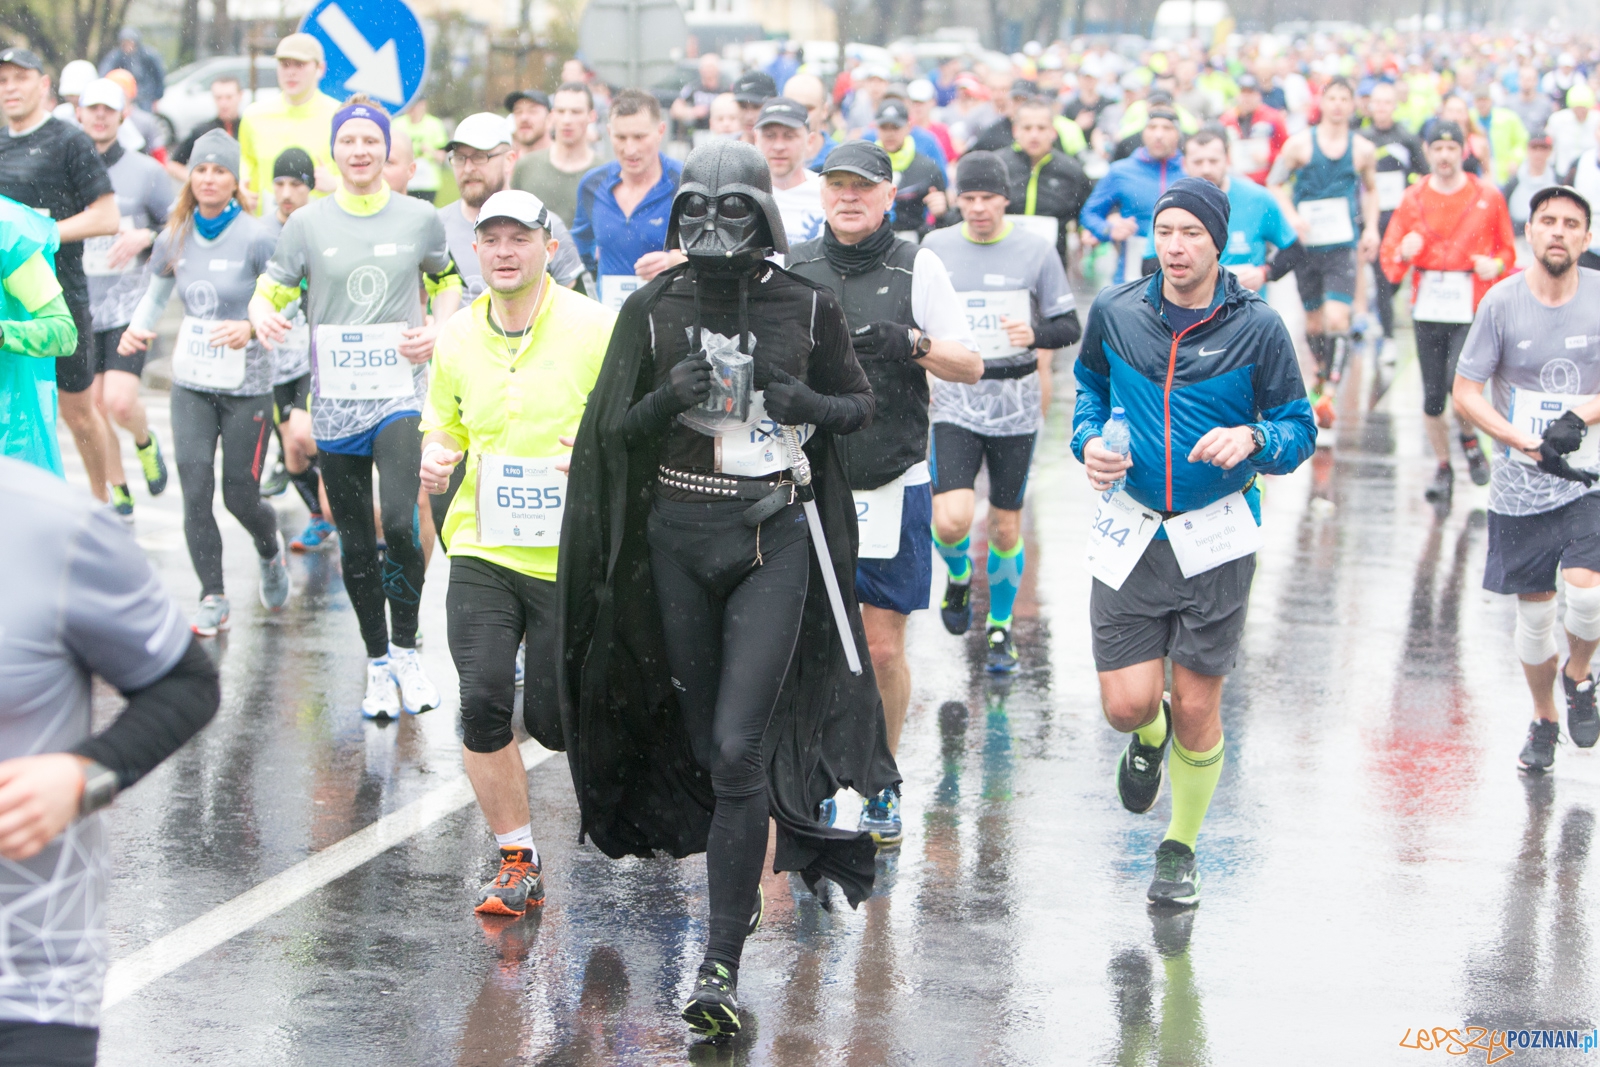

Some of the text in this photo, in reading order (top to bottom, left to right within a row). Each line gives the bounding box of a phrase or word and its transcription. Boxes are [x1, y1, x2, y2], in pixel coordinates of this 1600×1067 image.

[330, 348, 398, 368] 12368
[496, 486, 562, 509] 6535
[1209, 540, 1232, 554] Kuby
